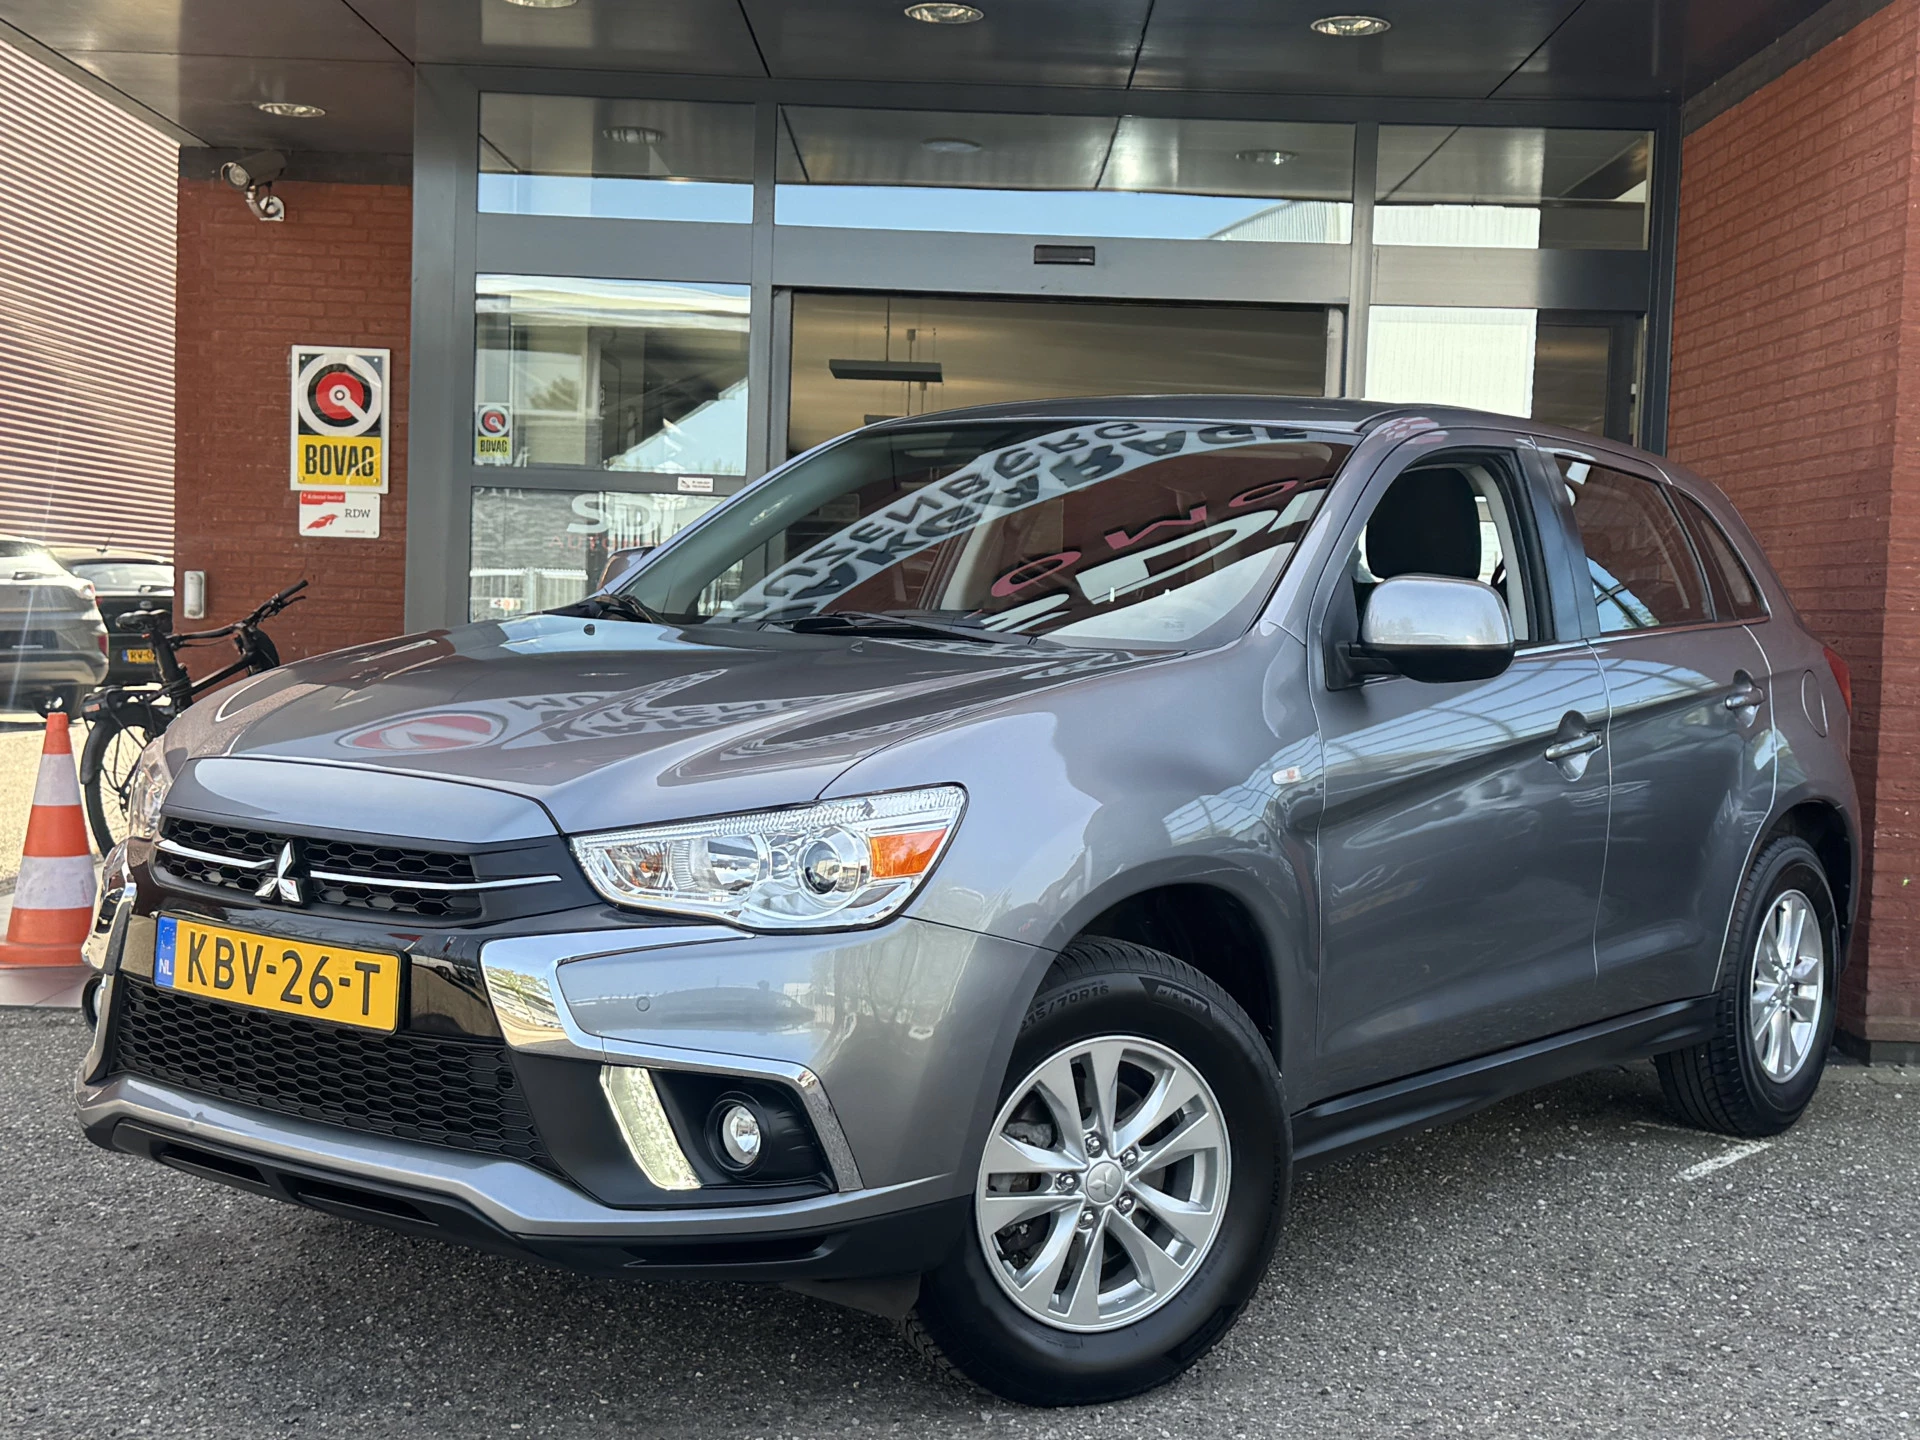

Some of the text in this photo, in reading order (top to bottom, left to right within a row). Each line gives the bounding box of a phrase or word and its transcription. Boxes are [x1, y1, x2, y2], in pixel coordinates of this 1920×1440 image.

[304, 443, 374, 477] BOVAG
[344, 508, 371, 518] RDW
[130, 650, 153, 661] RV-0
[158, 957, 172, 976] NL
[187, 931, 381, 1016] KBV-26-T
